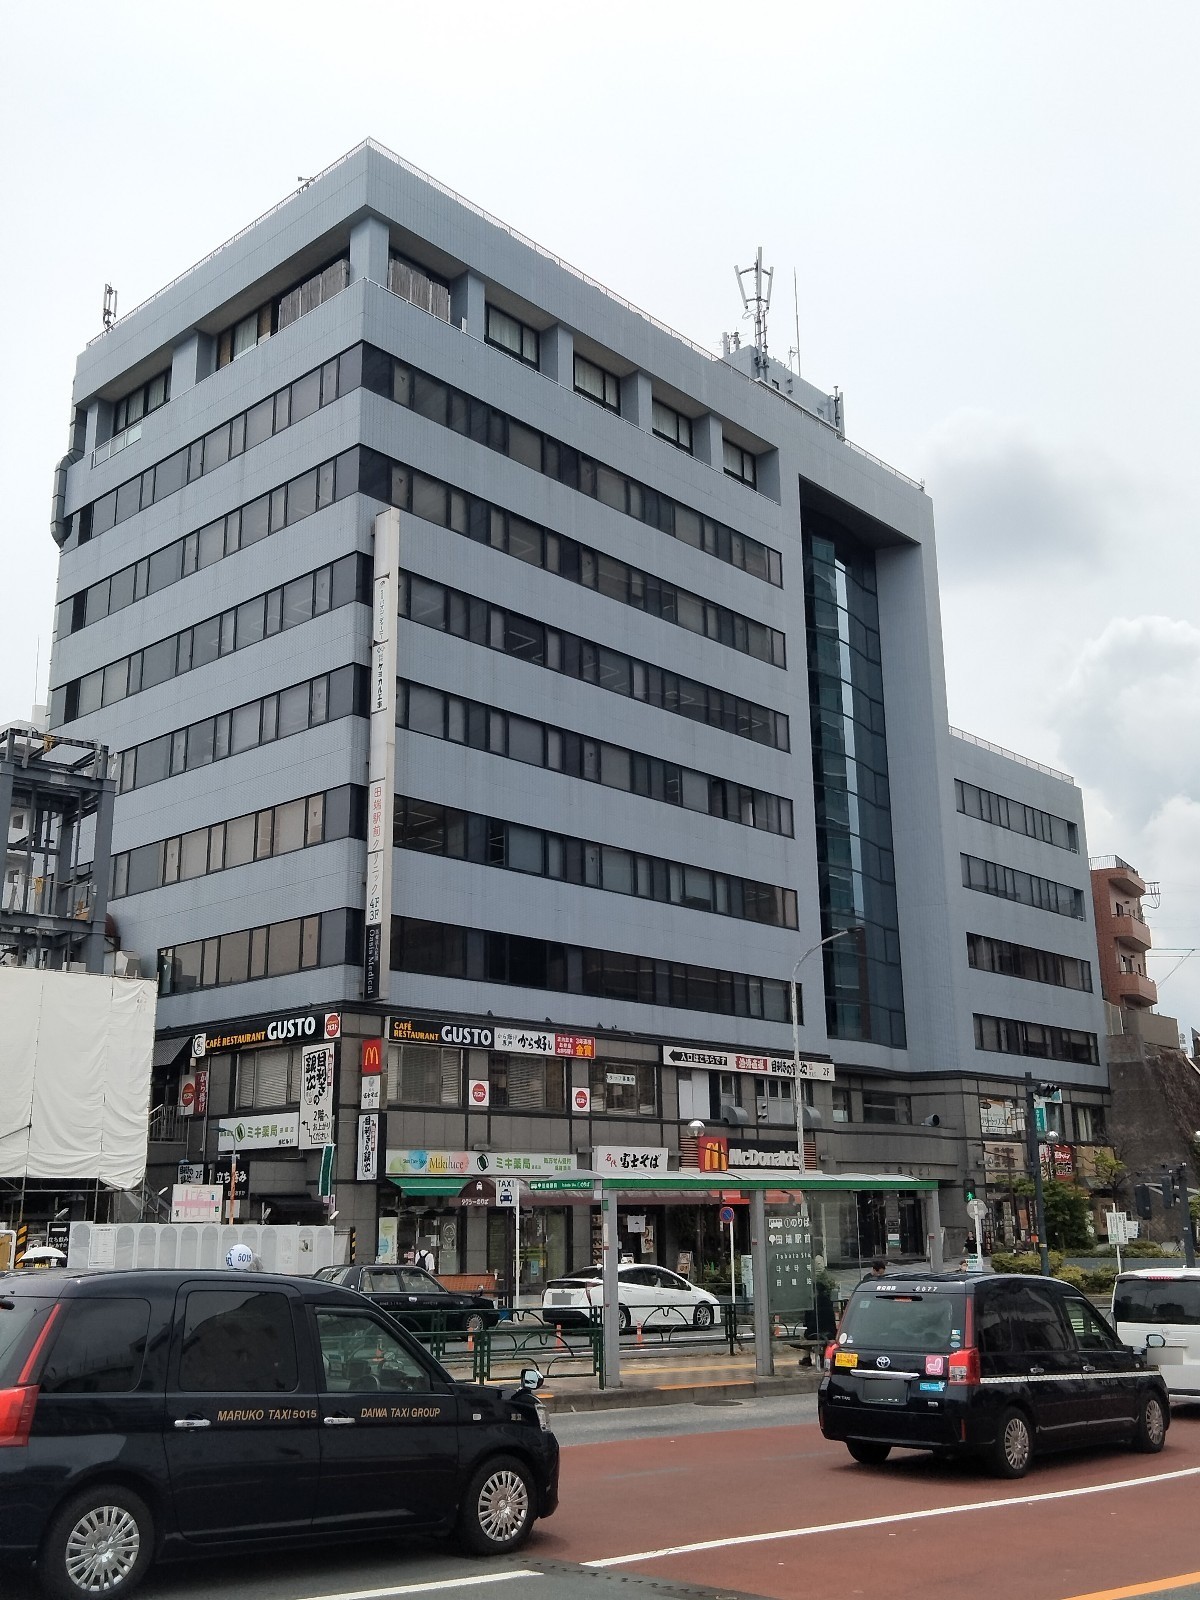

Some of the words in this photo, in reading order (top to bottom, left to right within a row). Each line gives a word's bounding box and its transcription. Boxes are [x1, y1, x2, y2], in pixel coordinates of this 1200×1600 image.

[371, 787, 382, 895] 田端駅前クリニック
[369, 897, 380, 909] 4F
[369, 909, 380, 921] 3F
[394, 1020, 412, 1031] CAFÉ
[205, 1035, 221, 1048] CAFÉ
[222, 1031, 266, 1046] RESTAURANT
[267, 1016, 316, 1040] GUSTO
[393, 1029, 440, 1041] RESTAURANT
[441, 1025, 492, 1046] GUSTO
[517, 1033, 553, 1051] から好し
[575, 1044, 592, 1056] 金賞
[681, 1052, 727, 1065] 入口はこちらです
[823, 1068, 830, 1076] 2F
[313, 1109, 329, 1121] 2階へ
[247, 1124, 278, 1138] ミキ薬局
[313, 1121, 330, 1131] お上がり
[313, 1132, 329, 1141] ください
[429, 1155, 464, 1169] Mikiluce
[496, 1157, 531, 1169] ミキ薬局
[620, 1153, 662, 1168] 富士そば
[728, 1148, 800, 1166] McDonald's
[776, 1233, 811, 1245] 田端駅前
[217, 1409, 264, 1421] MARUKO
[268, 1409, 292, 1420] TAXI
[292, 1409, 317, 1419] 5015
[360, 1408, 388, 1418] DAIWA
[390, 1408, 410, 1418] TAXI
[411, 1408, 441, 1418] GROUP
